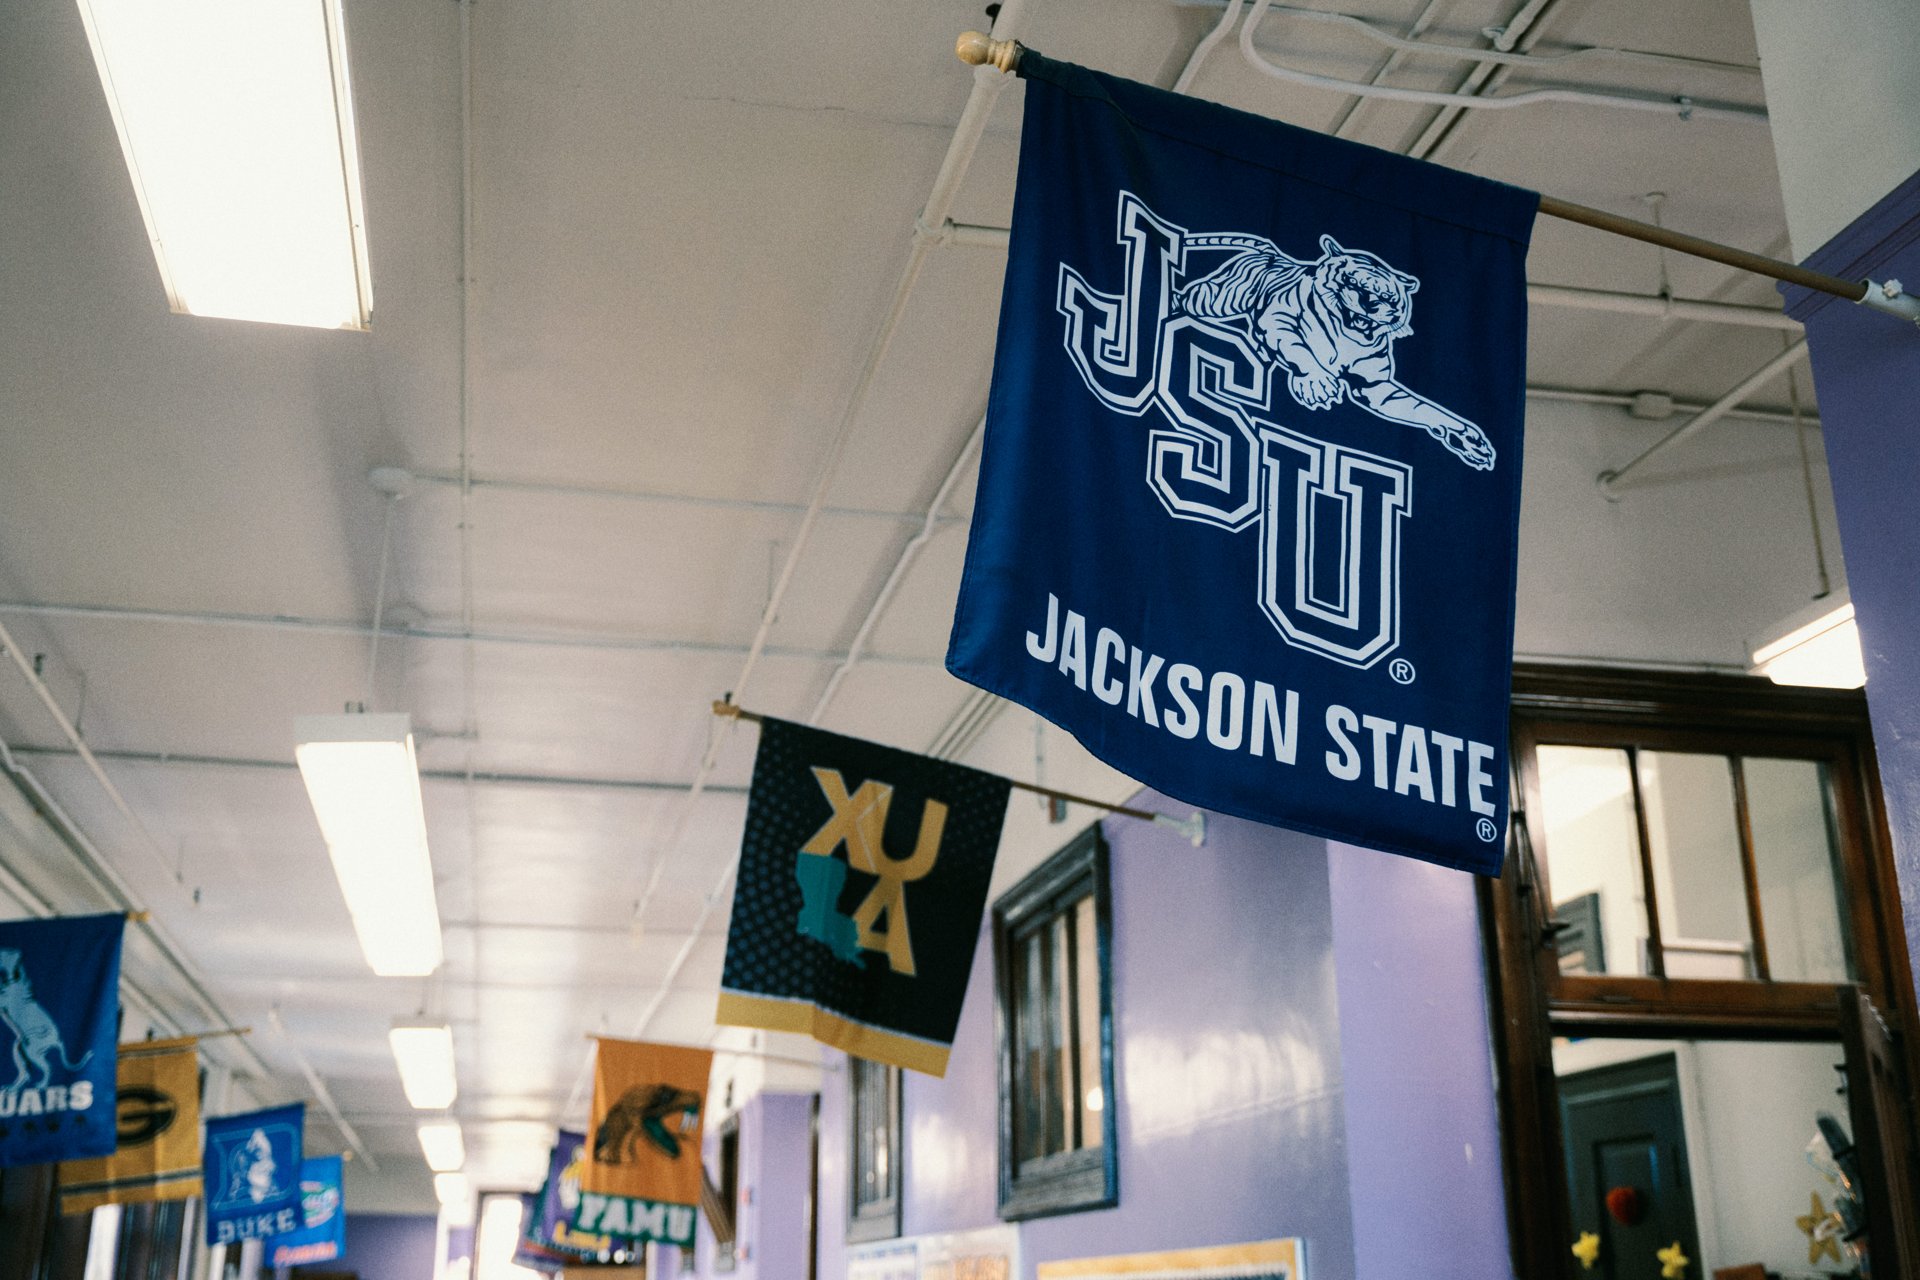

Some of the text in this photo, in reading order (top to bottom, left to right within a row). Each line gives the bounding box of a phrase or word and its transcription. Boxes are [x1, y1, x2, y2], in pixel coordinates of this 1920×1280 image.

[1057, 188, 1413, 669] JSU
[1025, 592, 1497, 818] JACKSON STATE
[217, 1207, 296, 1244] DUKE
